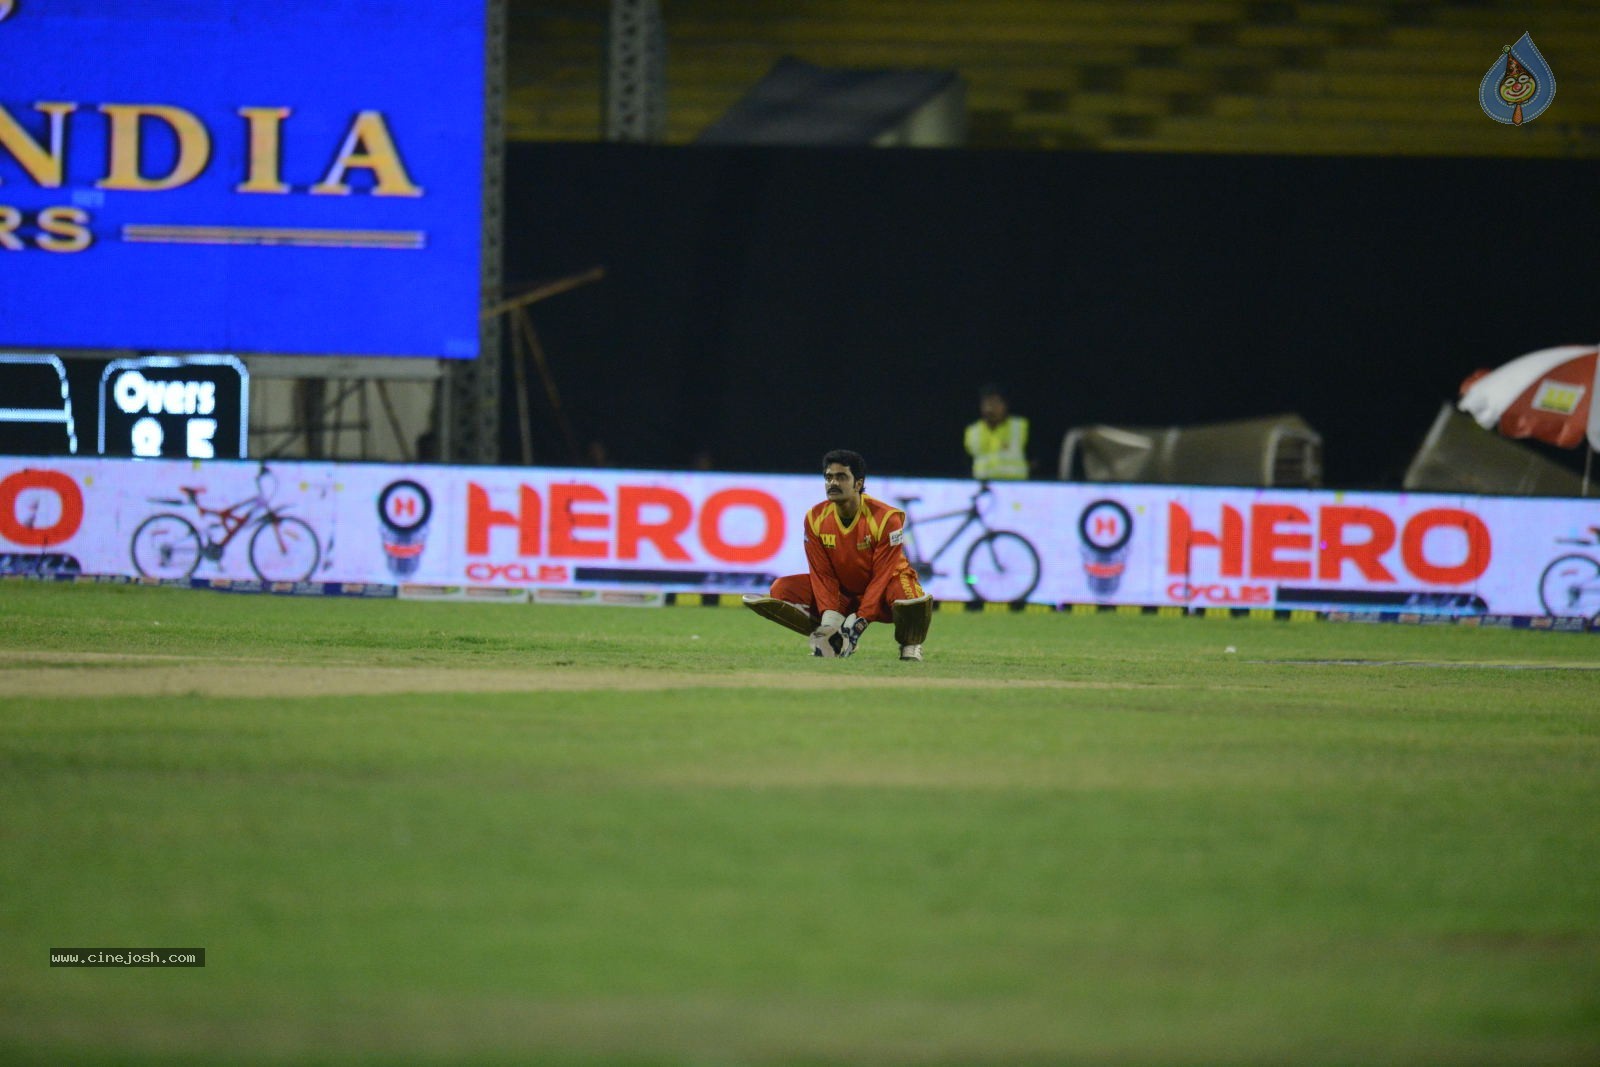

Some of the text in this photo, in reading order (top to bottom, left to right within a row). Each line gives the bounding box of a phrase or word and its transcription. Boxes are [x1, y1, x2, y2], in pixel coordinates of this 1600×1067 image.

[114, 370, 216, 415] Overs
[466, 481, 787, 565] HERO
[1166, 501, 1493, 586] HERO
[465, 563, 569, 584] CYCLES
[1165, 582, 1271, 604] CYCLES
